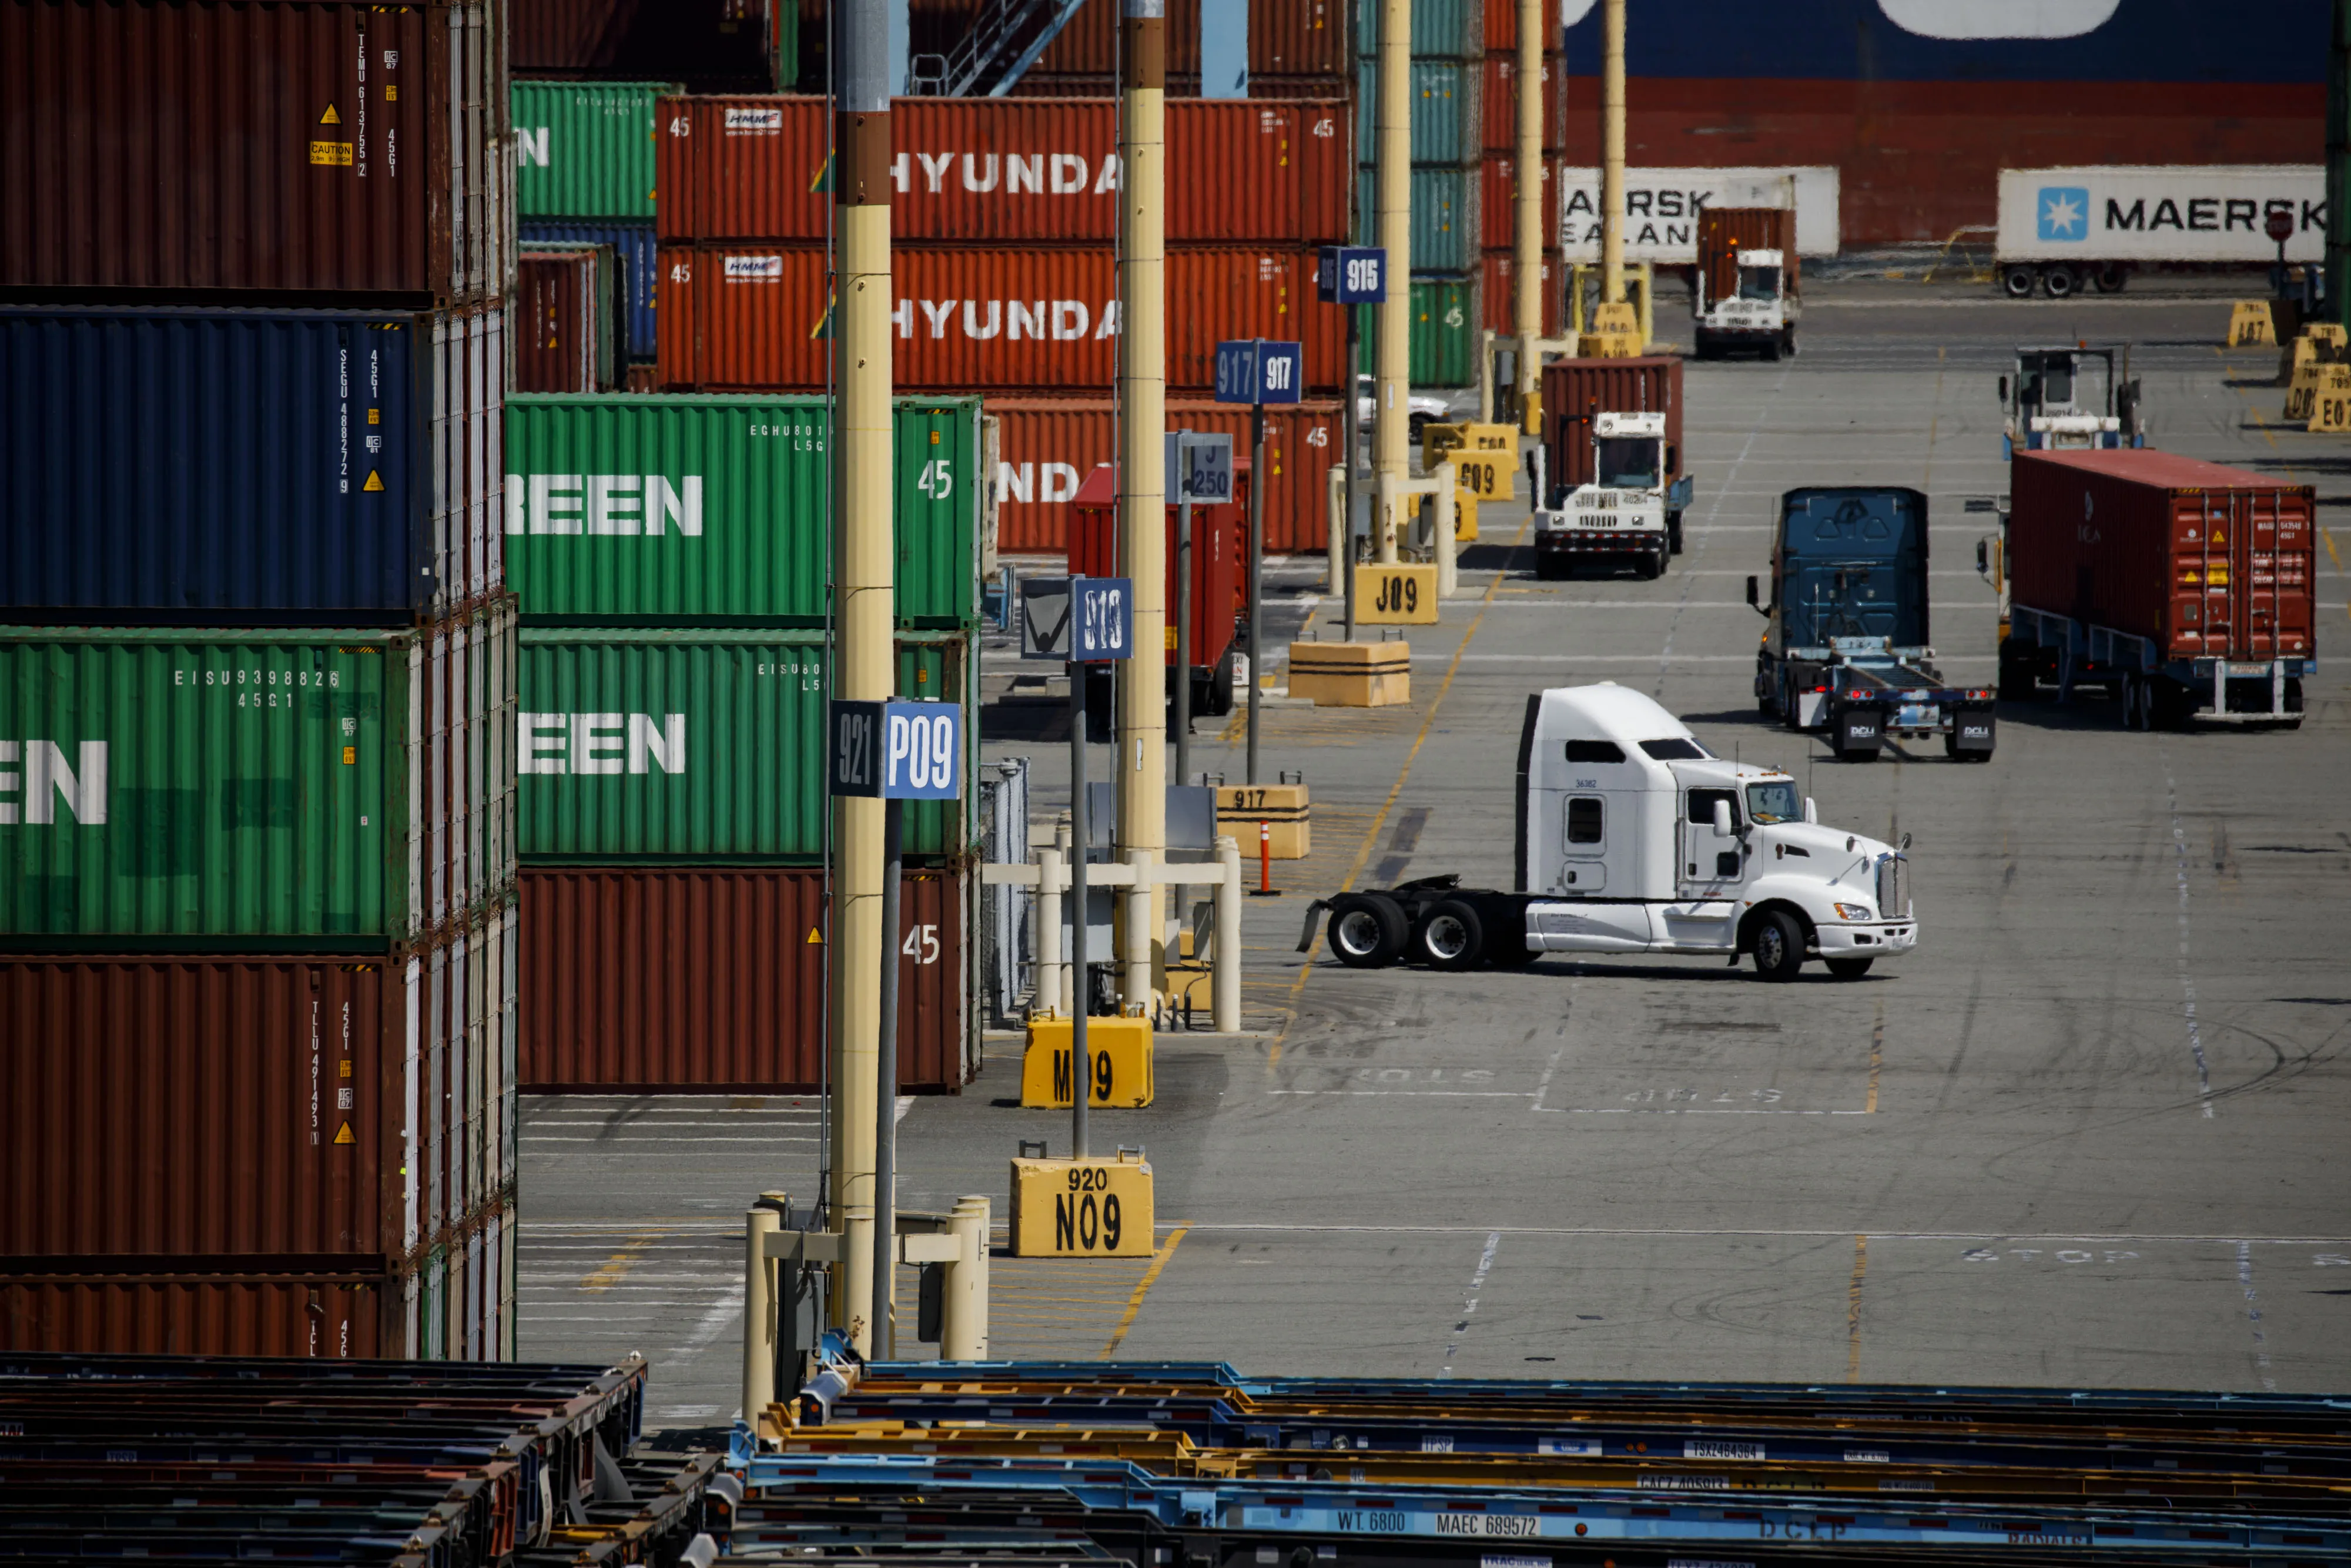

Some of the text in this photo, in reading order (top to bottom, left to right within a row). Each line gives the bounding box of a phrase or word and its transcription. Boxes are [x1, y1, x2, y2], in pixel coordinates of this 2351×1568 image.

[669, 116, 689, 137] 45
[1313, 119, 1334, 137] 45
[312, 145, 350, 155] CAUTION
[515, 127, 549, 166] N
[358, 163, 366, 176] 2
[1566, 189, 1713, 217] ARSK
[671, 263, 691, 283] 45
[1347, 259, 1378, 292] 915
[1218, 350, 1252, 395] 917
[1266, 356, 1291, 390] 917
[751, 425, 833, 436] EGHU801
[1306, 427, 1328, 447] 45
[795, 440, 823, 451] L5G
[340, 479, 348, 493] 9
[918, 460, 952, 499] 45
[1194, 470, 1228, 495] 250
[1376, 577, 1418, 613] J09
[1084, 589, 1122, 649] 919
[758, 664, 826, 675] EISU80
[802, 679, 826, 691] L5
[238, 693, 292, 708] 45G1
[839, 713, 872, 785] 921
[889, 715, 953, 789] P09
[0, 740, 107, 825] N
[1234, 789, 1266, 809] 917
[903, 924, 940, 964] 45
[1053, 1049, 1113, 1103] M9
[1068, 1168, 1107, 1191] 920
[1056, 1193, 1121, 1251] N09
[1369, 1512, 1405, 1532] 6800
[1437, 1515, 1538, 1536] MAEC 689572
